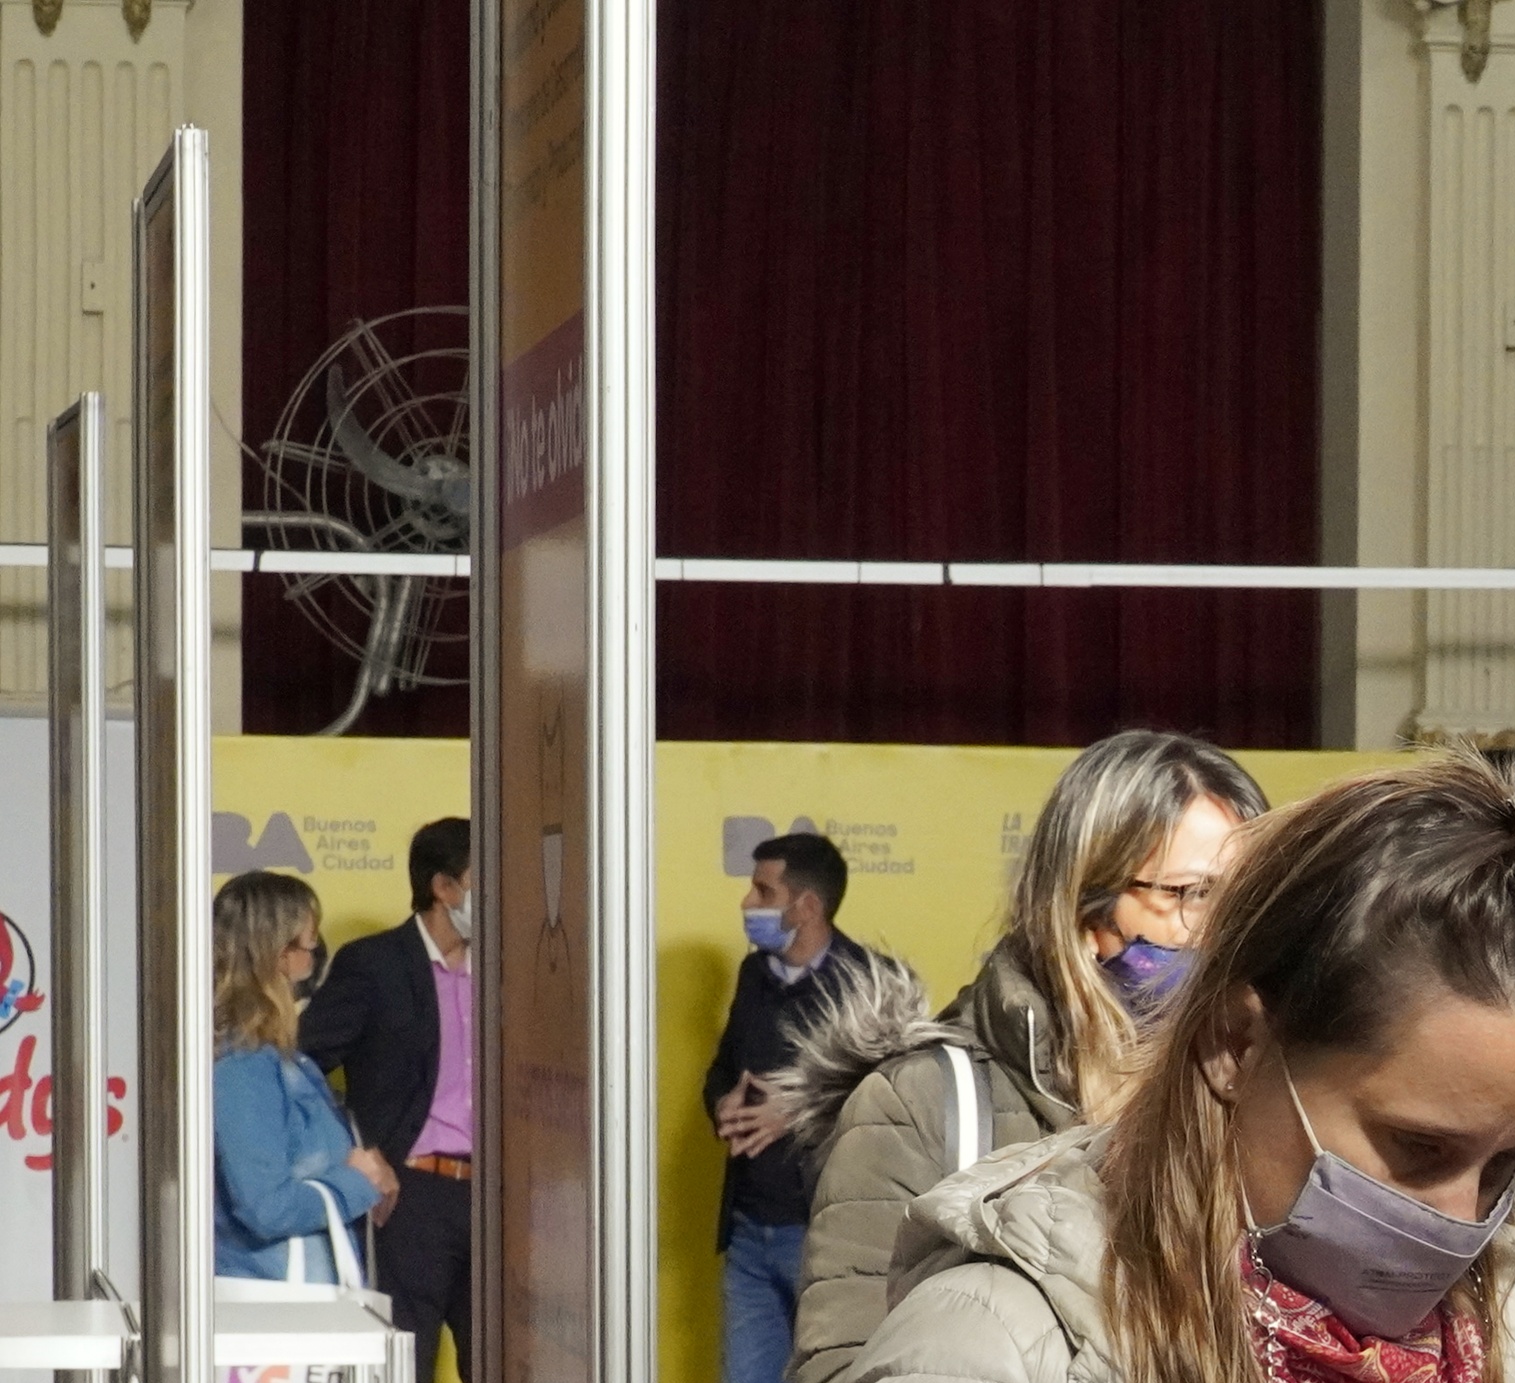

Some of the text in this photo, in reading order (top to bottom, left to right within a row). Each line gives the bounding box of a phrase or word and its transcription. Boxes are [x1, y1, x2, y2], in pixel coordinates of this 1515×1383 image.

[303, 816, 376, 833] Buenos
[826, 819, 897, 836] Buenos
[317, 835, 370, 851] Aires
[840, 839, 890, 855] Aires
[322, 854, 394, 870] Ciudad
[848, 857, 914, 874] Ciudad
